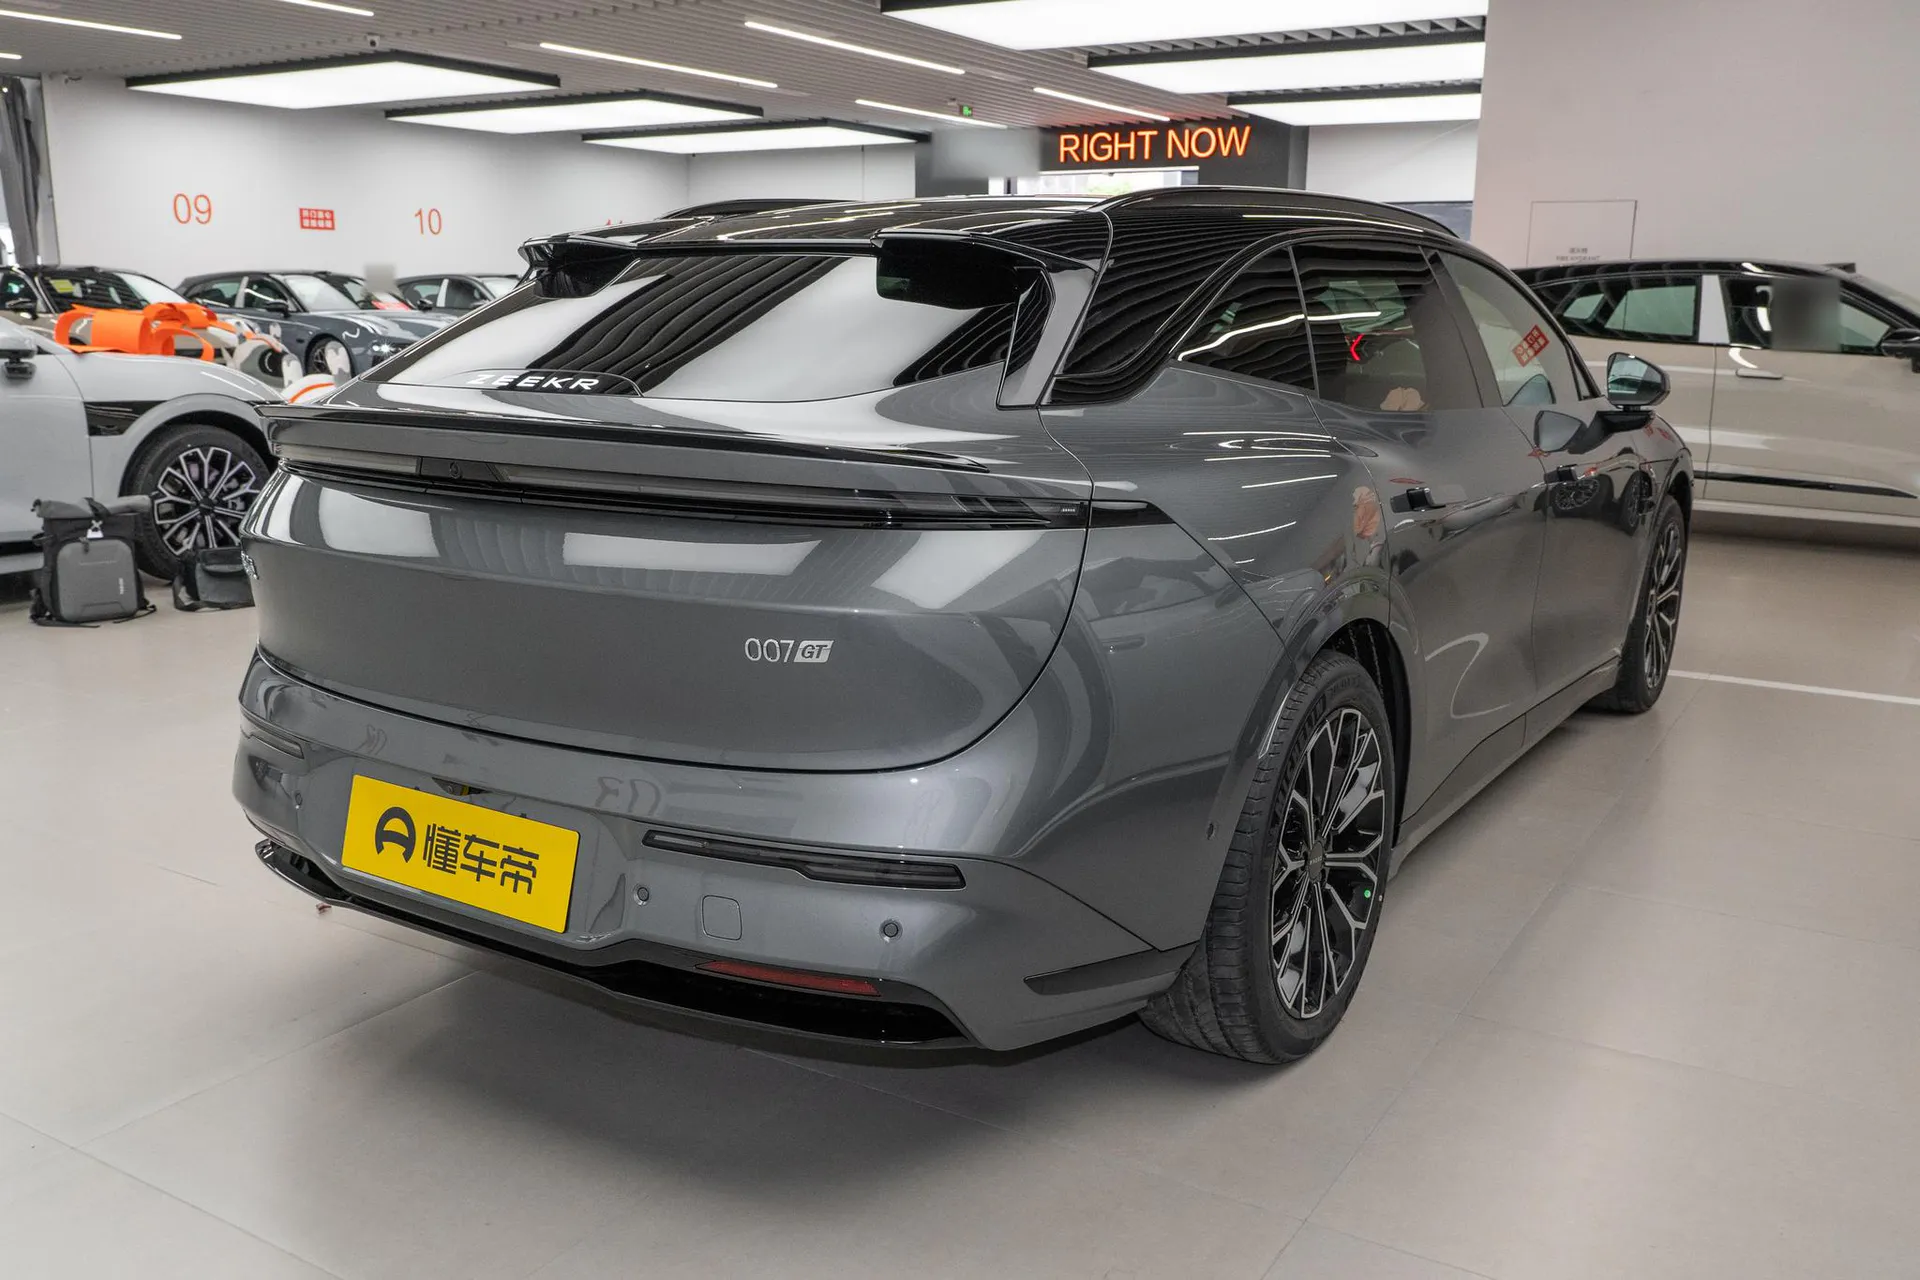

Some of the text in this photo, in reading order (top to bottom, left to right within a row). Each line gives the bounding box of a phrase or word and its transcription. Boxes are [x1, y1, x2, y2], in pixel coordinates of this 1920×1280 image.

[1058, 125, 1252, 164] RIGHT NOW
[172, 192, 213, 225] 09
[414, 207, 443, 236] 10
[465, 373, 601, 391] ZEEKR
[744, 637, 831, 663] 007 GT
[422, 823, 540, 895] 懂车帝
